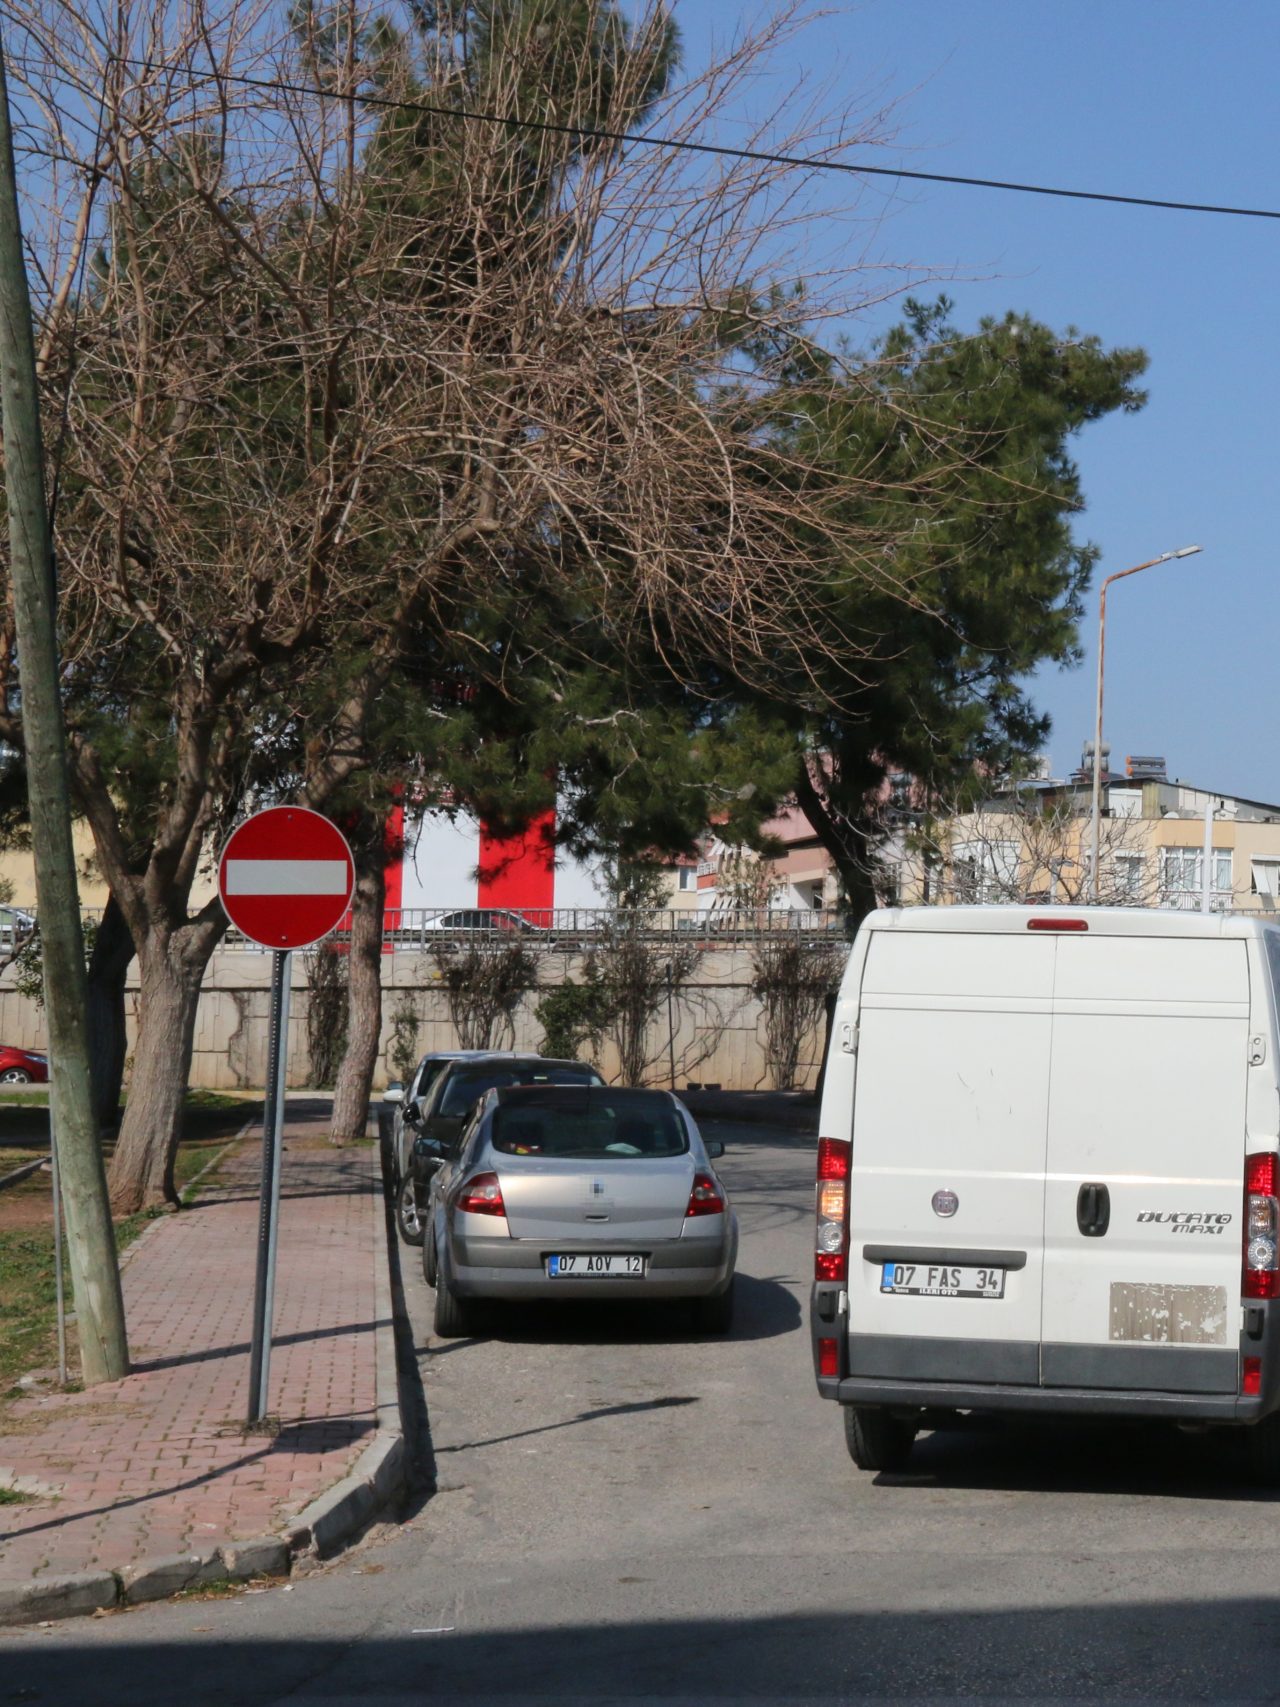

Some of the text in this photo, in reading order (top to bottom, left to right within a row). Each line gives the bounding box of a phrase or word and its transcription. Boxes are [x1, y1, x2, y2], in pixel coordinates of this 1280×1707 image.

[1136, 1211, 1232, 1225] DUCATO
[1171, 1224, 1225, 1234] MAXI
[559, 1255, 640, 1272] 07 AOV 12
[893, 1265, 916, 1286] 07
[927, 1266, 962, 1288] FAS
[976, 1269, 998, 1290] 34
[941, 1288, 958, 1296] OTO
